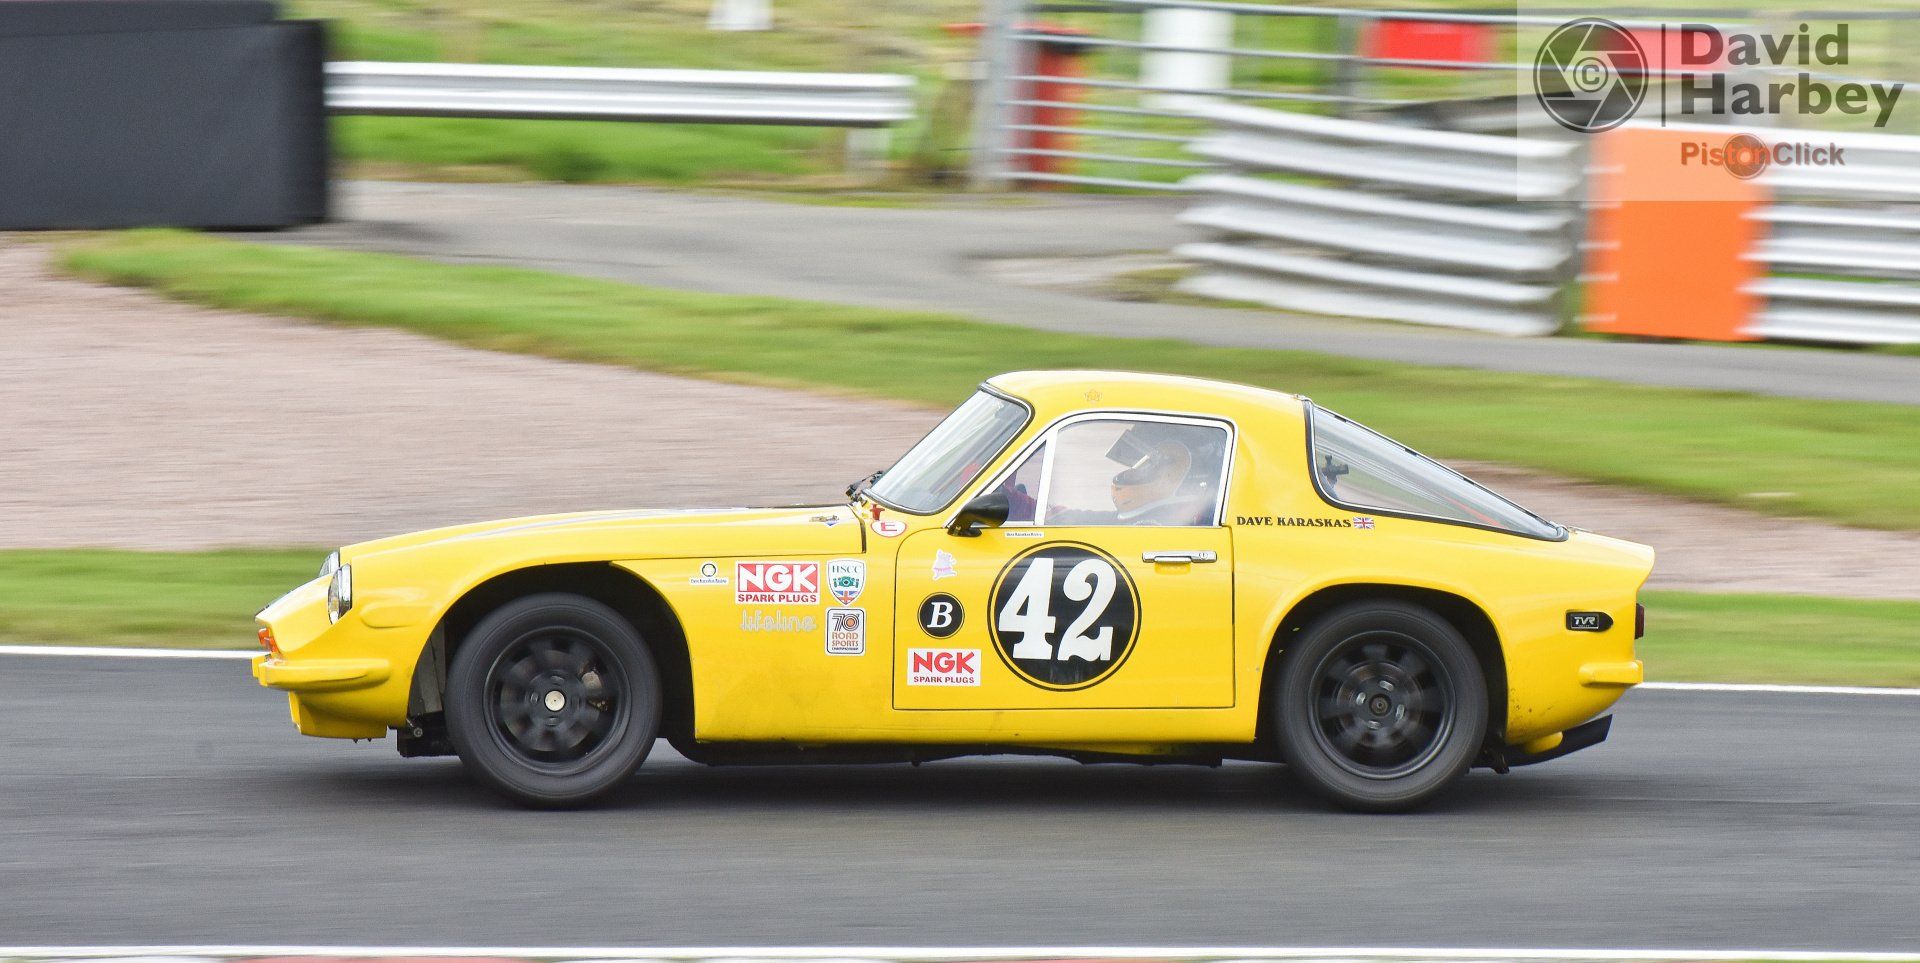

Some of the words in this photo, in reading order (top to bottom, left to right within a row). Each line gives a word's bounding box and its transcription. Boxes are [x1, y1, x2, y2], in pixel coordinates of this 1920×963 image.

[1236, 516, 1273, 526] DAVE
[1277, 517, 1352, 528] KARASKAS
[738, 564, 817, 592] NGK
[738, 594, 775, 603] SPARK
[778, 594, 817, 603] PLUGS
[926, 601, 954, 628] B
[998, 557, 1117, 662] 42
[741, 610, 816, 632] lifeline
[1574, 616, 1595, 624] TVR
[832, 632, 859, 640] ROAD
[913, 651, 975, 674] NGK
[944, 676, 975, 684] PLUGS
